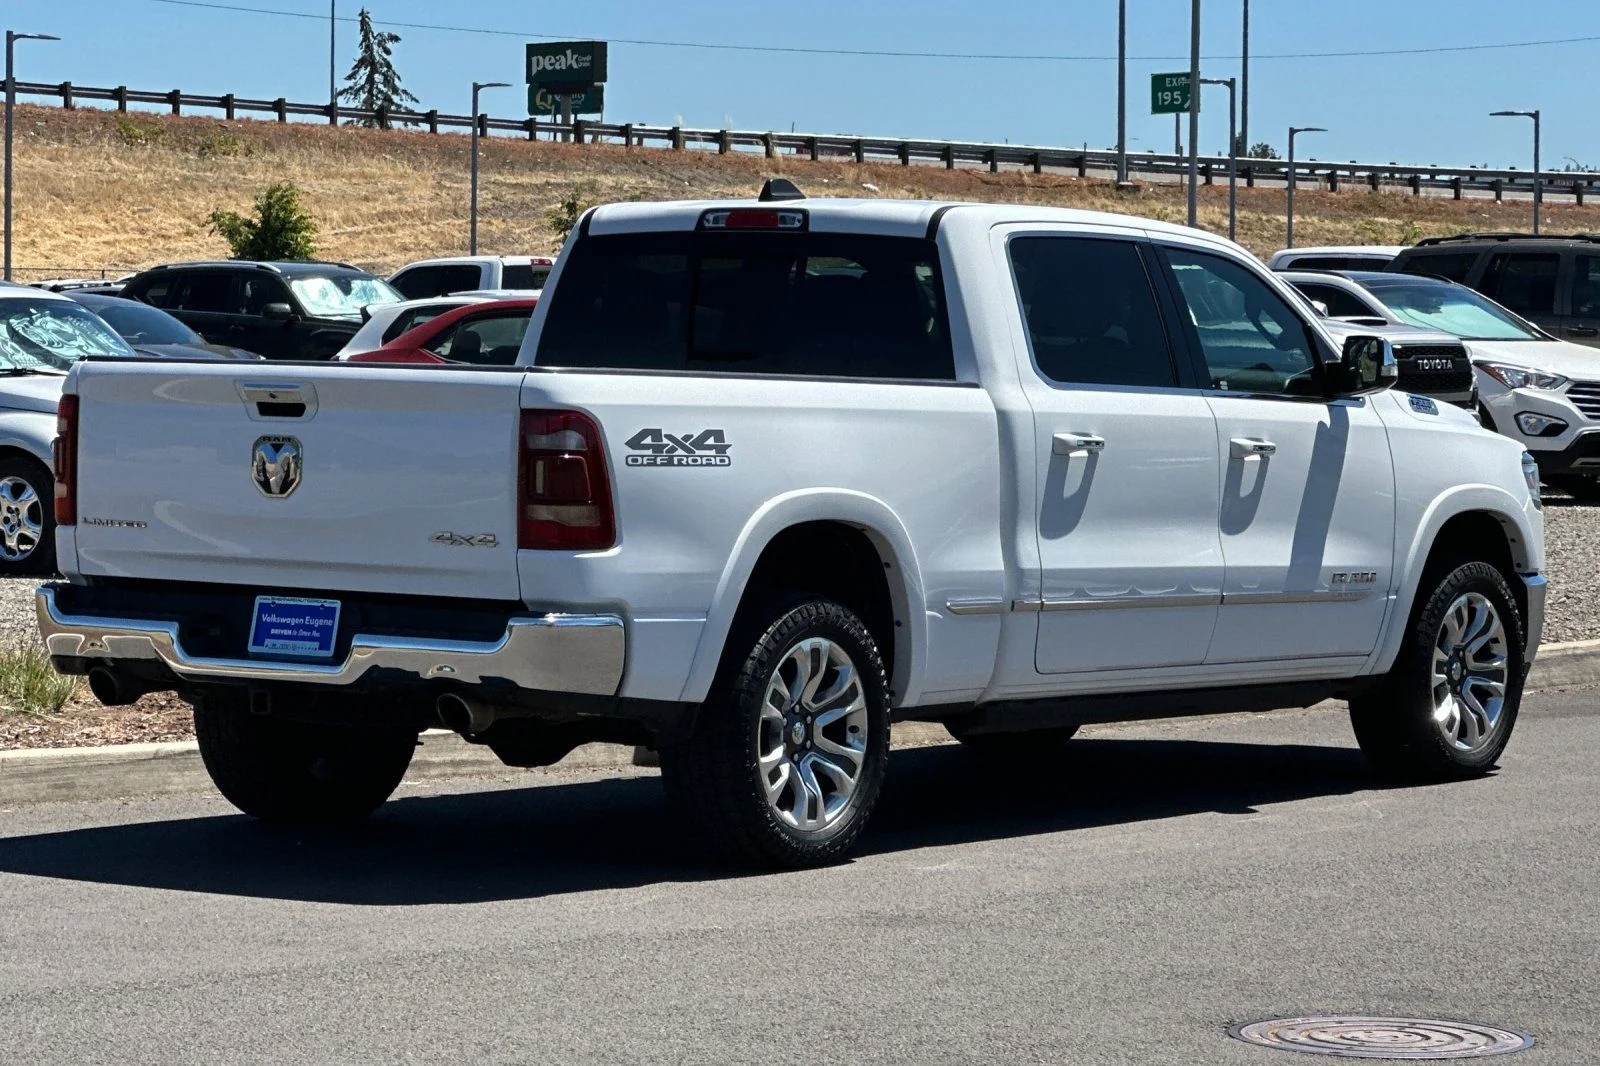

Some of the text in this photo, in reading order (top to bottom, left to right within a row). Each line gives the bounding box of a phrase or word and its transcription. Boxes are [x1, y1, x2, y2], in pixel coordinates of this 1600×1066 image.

[531, 49, 578, 76] peak
[1157, 91, 1181, 105] 195
[1417, 358, 1453, 370] TOYOTA
[624, 428, 732, 454] 4x4
[627, 456, 730, 465] OFF ROAD
[430, 530, 500, 547] 4x4
[1332, 571, 1377, 584] RAM
[261, 613, 334, 627] Volkswagen Eugene
[270, 628, 292, 636] DRIVEN
